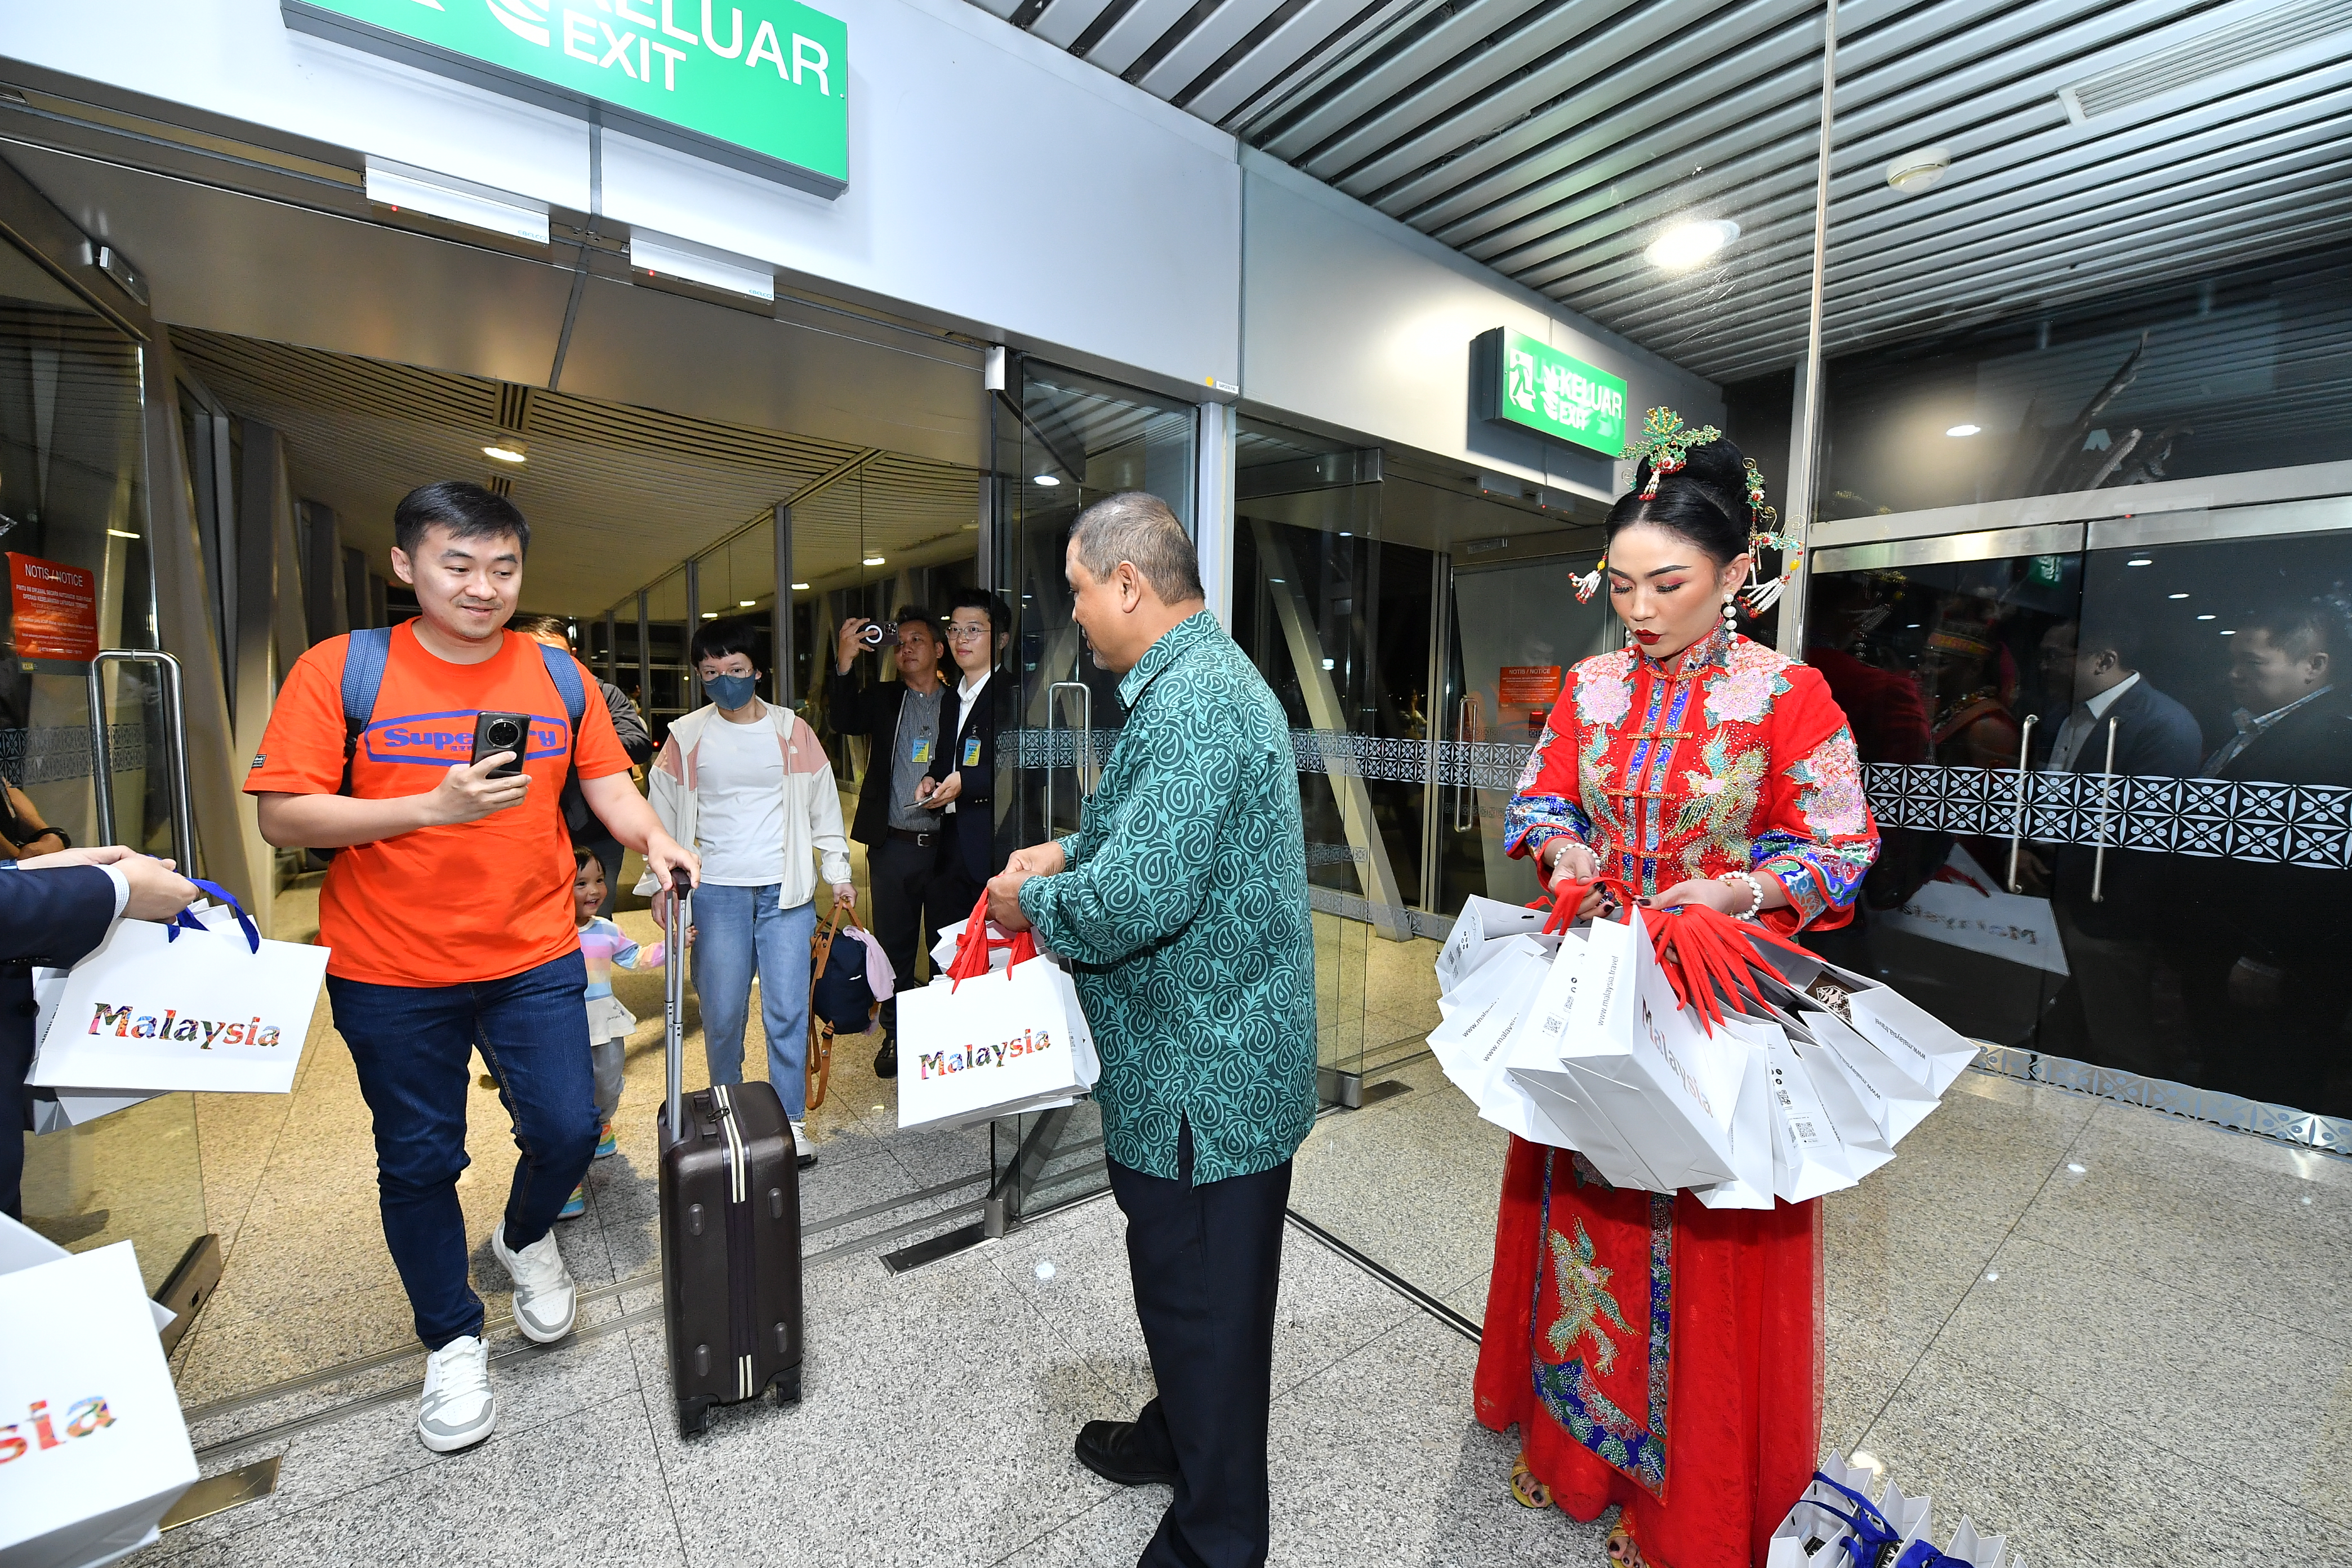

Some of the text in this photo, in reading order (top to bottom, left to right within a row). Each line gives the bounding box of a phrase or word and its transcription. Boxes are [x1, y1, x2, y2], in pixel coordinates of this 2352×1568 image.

[563, 8, 687, 92] EXIT
[597, 0, 830, 96] LUAR
[1559, 400, 1588, 431] EXIT
[1560, 368, 1623, 420] KELUAR
[25, 564, 50, 578] NOTIS
[57, 571, 83, 587] NOTICE
[384, 728, 556, 751] Supey
[1597, 955, 1619, 1026] www.malaysia.travel
[88, 1003, 280, 1050] Malaysia
[1874, 1018, 1927, 1060] www.malaysia.travel
[919, 1028, 1051, 1080] Malaysia
[1642, 994, 1713, 1119] Malaysia
